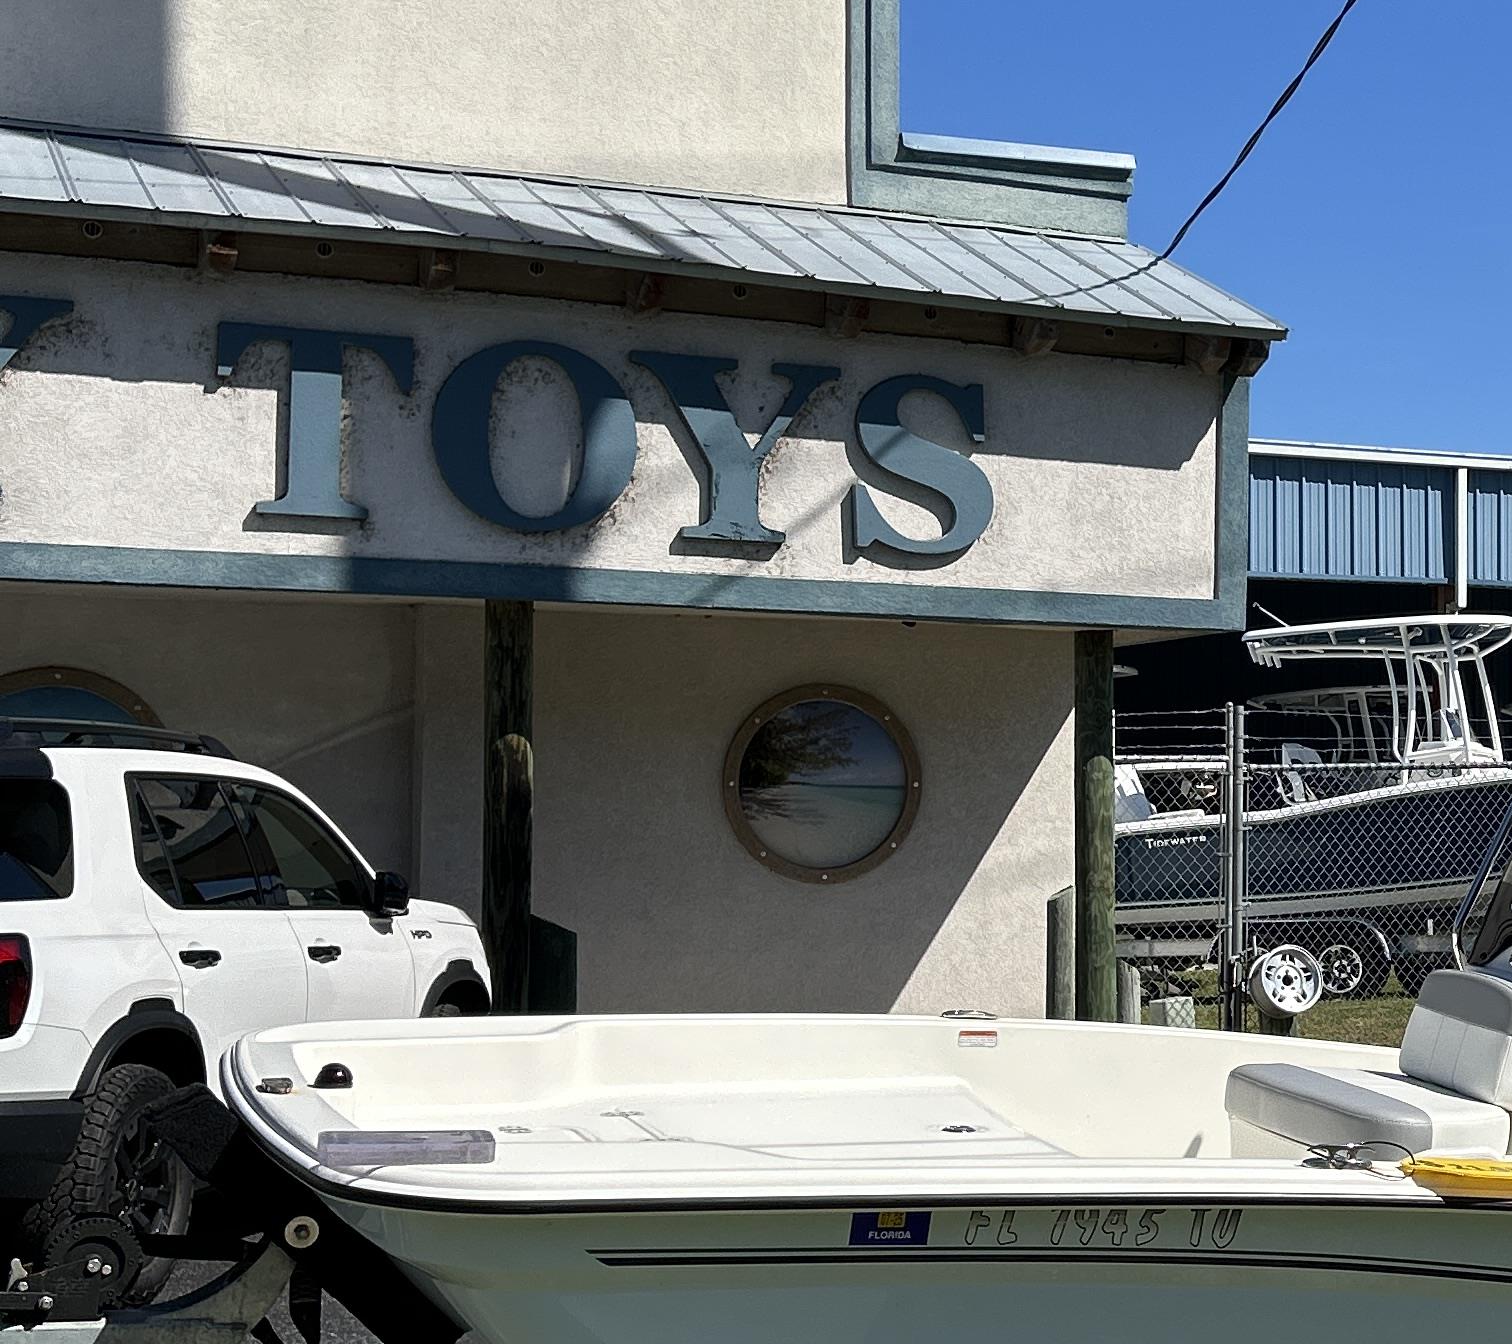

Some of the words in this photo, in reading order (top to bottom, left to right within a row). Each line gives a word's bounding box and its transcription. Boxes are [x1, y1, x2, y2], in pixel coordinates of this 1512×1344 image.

[217, 321, 994, 554] TOYS
[868, 1230, 912, 1240] FLORIDA
[964, 1209, 1018, 1246] FL
